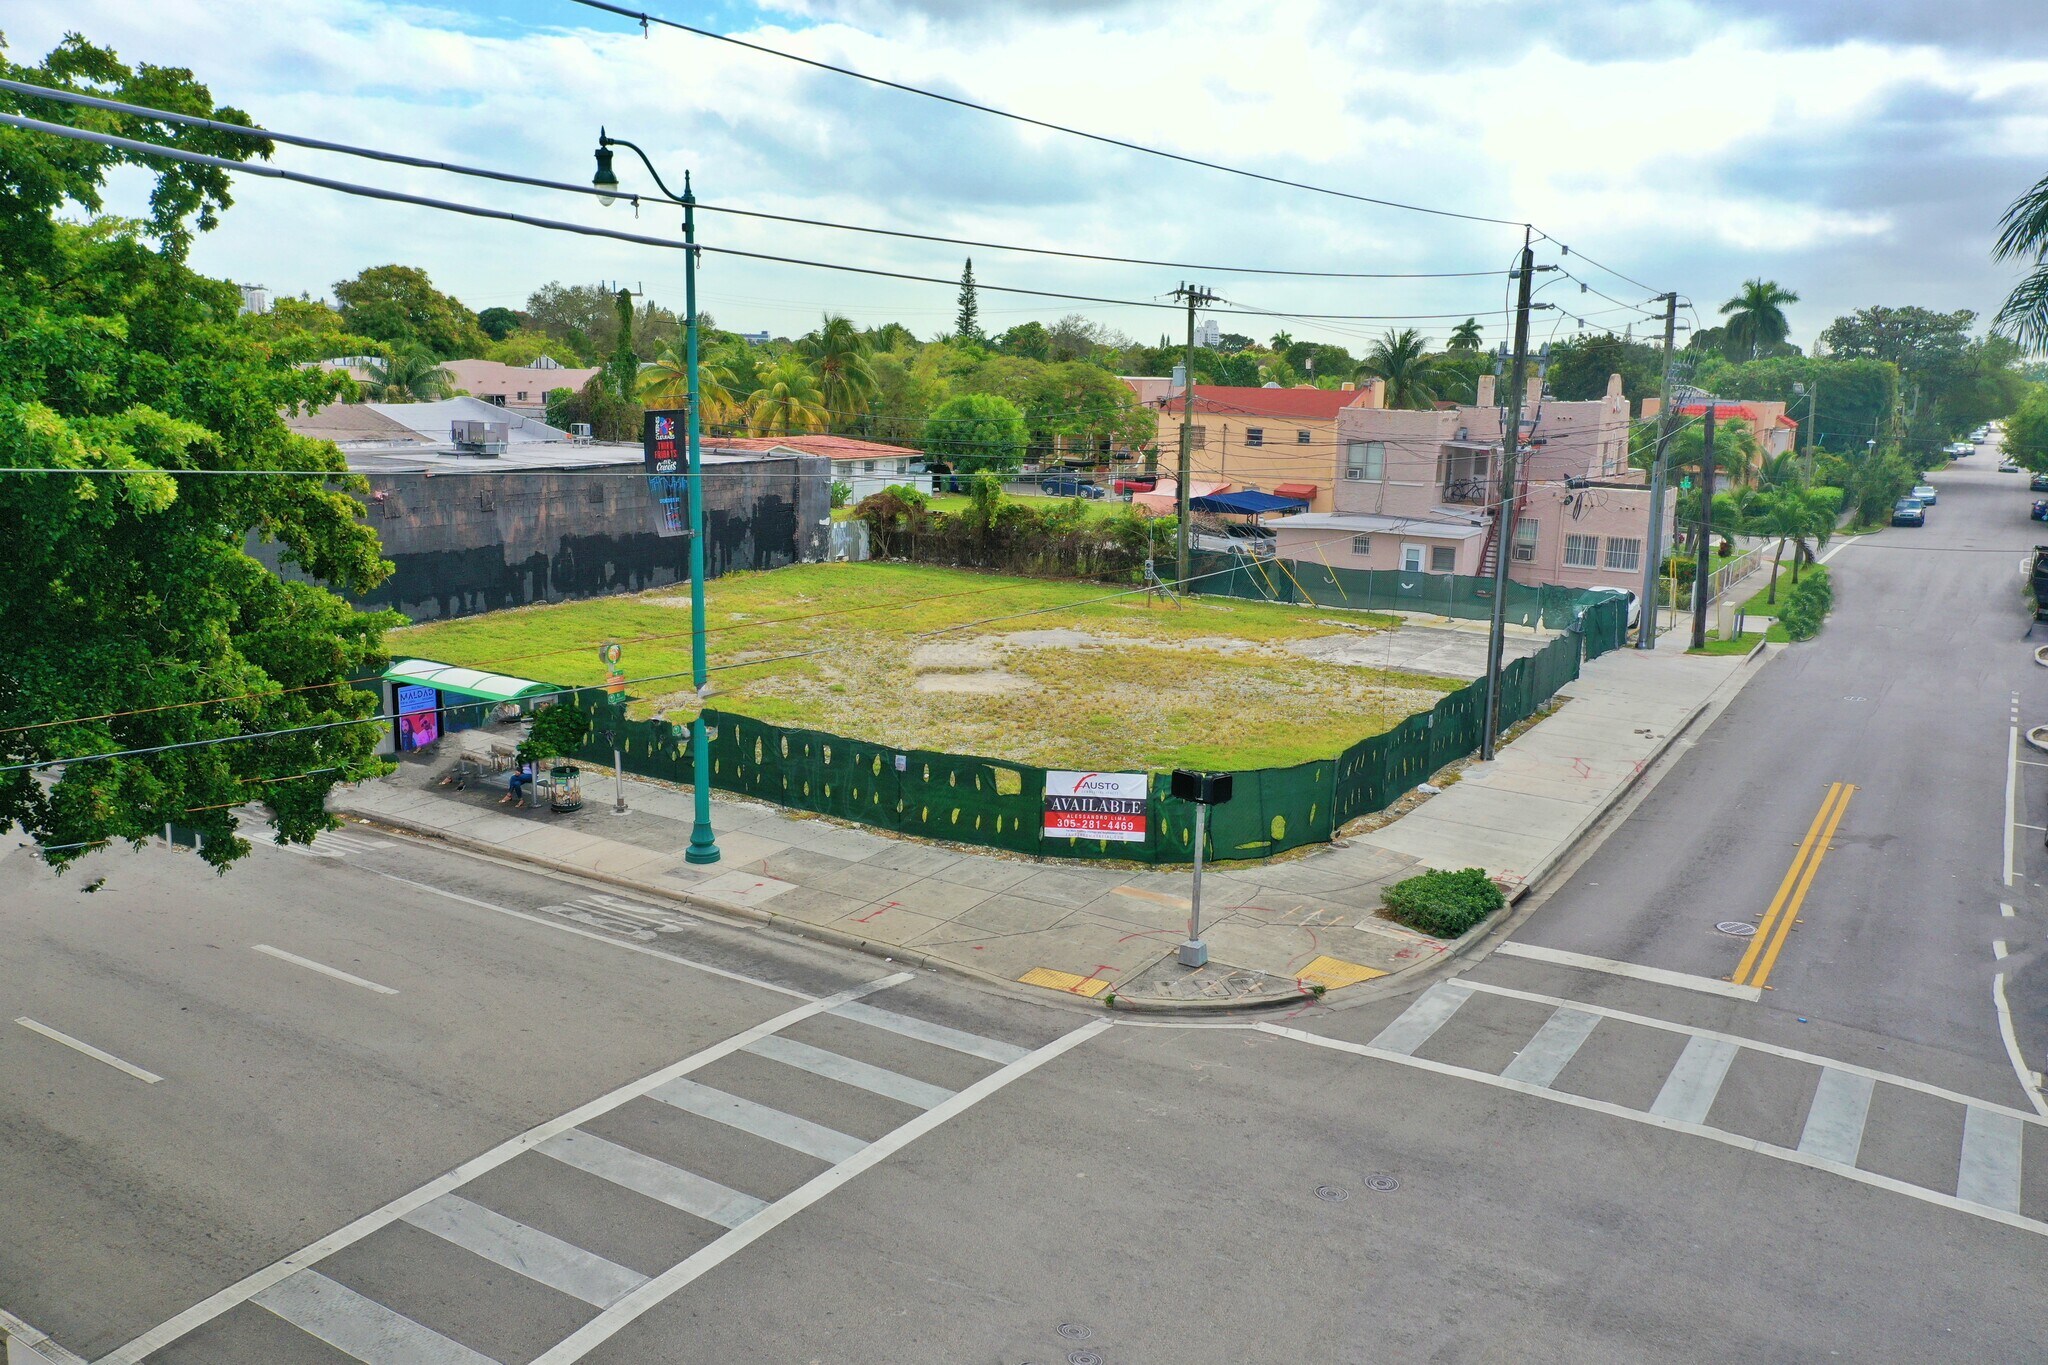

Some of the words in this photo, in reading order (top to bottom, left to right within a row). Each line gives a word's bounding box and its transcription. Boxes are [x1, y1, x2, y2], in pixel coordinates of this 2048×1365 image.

[400, 688, 435, 701] MALDAD
[1072, 773, 1120, 794] FAUSTO
[1051, 798, 1142, 814] AVAILABLE
[1057, 819, 1134, 830] 305-281-4469
[536, 893, 706, 941] BUS
